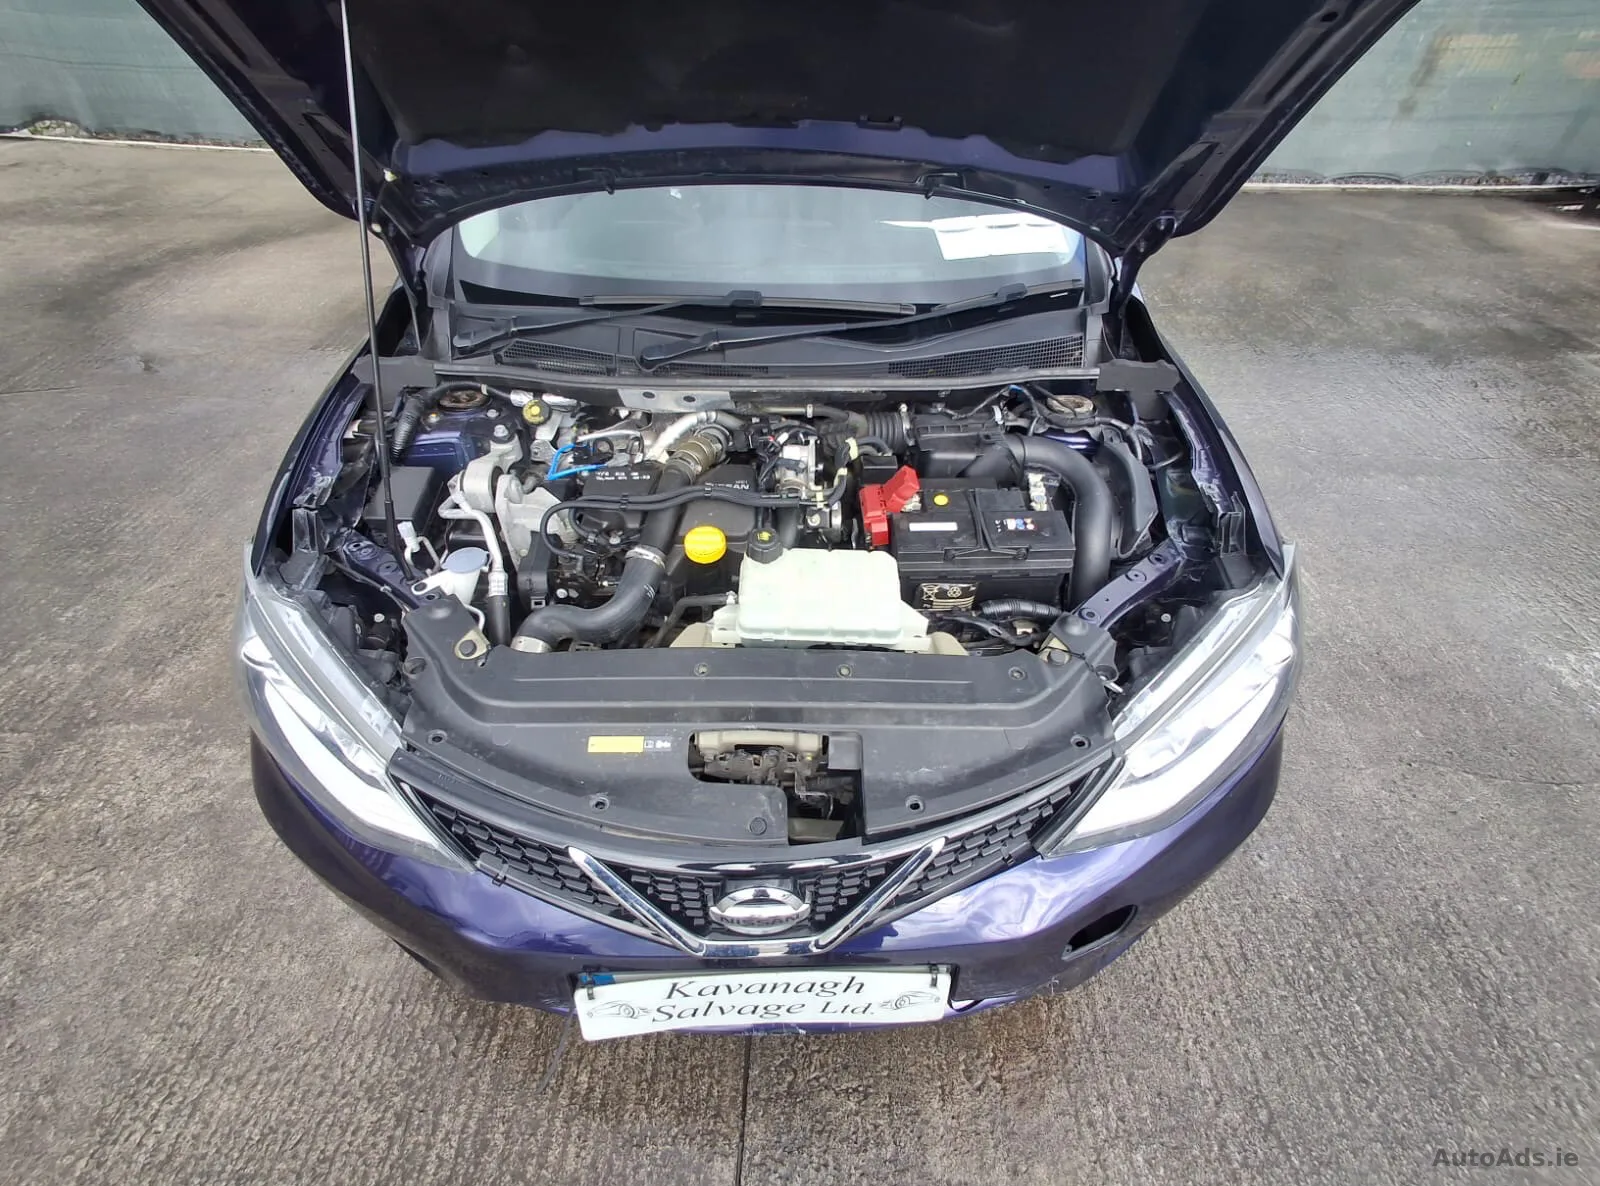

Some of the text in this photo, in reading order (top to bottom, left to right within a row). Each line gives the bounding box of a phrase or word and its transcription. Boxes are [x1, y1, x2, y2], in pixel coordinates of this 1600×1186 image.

[665, 976, 865, 999] Kavanagh
[652, 1001, 875, 1022] Salvage Ltd.
